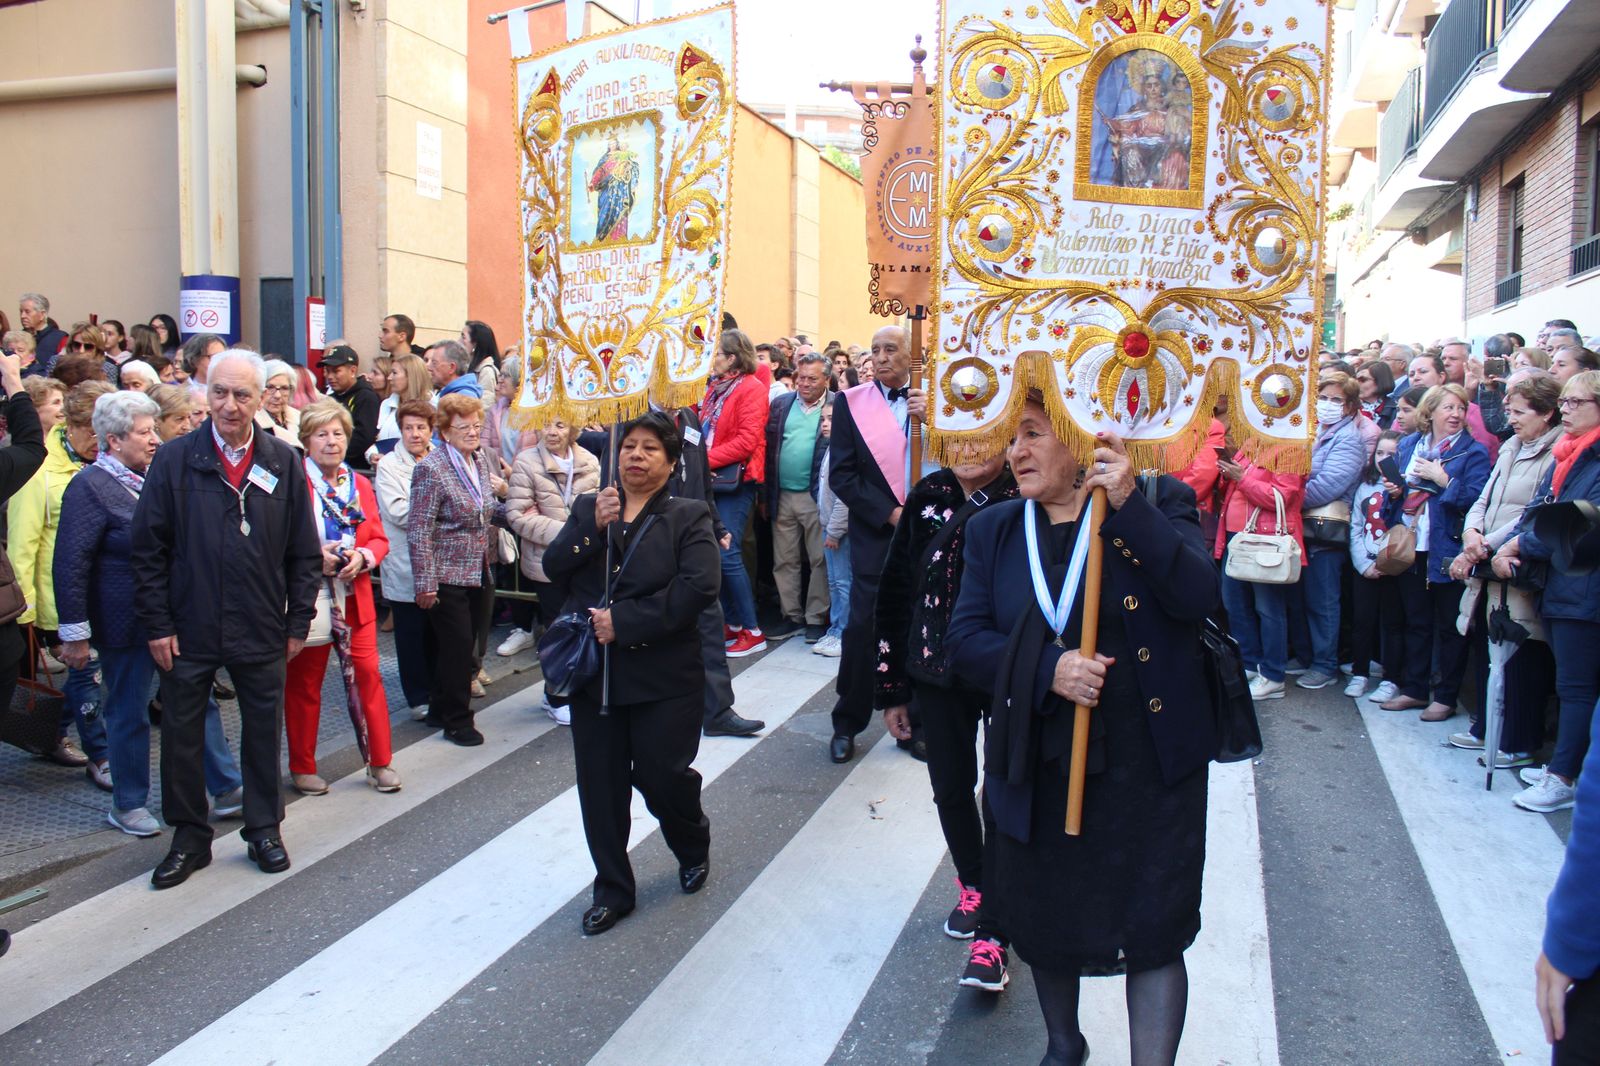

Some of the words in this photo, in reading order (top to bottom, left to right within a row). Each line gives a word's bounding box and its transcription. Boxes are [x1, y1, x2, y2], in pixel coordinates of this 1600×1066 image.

[561, 59, 589, 96] MARIA
[596, 43, 675, 67] AUXILIADORA
[566, 108, 579, 126] DE
[586, 102, 608, 120] LOS
[613, 89, 674, 115] MILAGROS
[906, 146, 922, 155] DE
[1138, 213, 1192, 235] Dina
[610, 247, 640, 266] DINA
[1053, 229, 1138, 254] Palomino
[1175, 236, 1209, 262] hija
[562, 266, 612, 288] PALOMINO
[616, 266, 624, 282] E
[627, 261, 661, 281] HIJOS
[1038, 244, 1130, 276] Veronica
[1134, 256, 1213, 286] Mendoza
[563, 286, 592, 305] PERU
[592, 299, 623, 317] 2023
